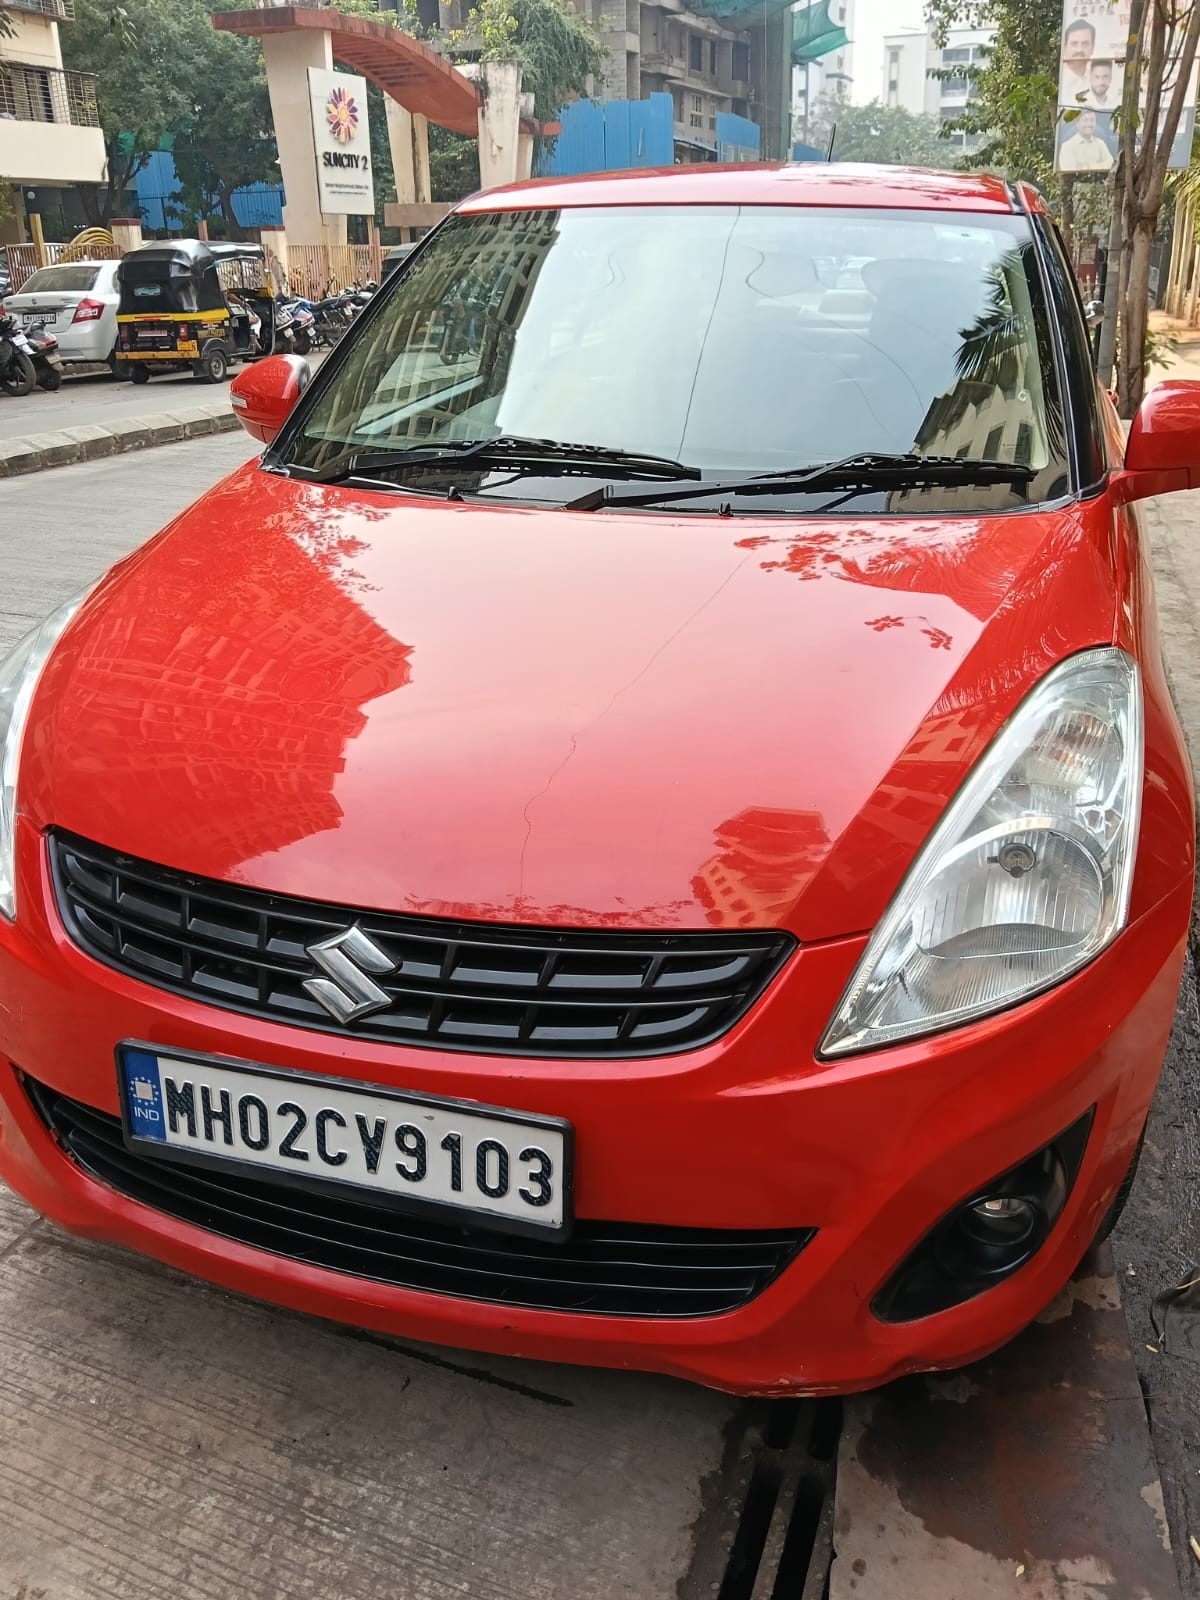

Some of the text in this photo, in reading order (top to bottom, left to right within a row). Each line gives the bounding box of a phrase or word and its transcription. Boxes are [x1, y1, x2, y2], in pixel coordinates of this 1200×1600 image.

[322, 151, 369, 170] SUNCITY 2
[134, 1106, 160, 1121] IND
